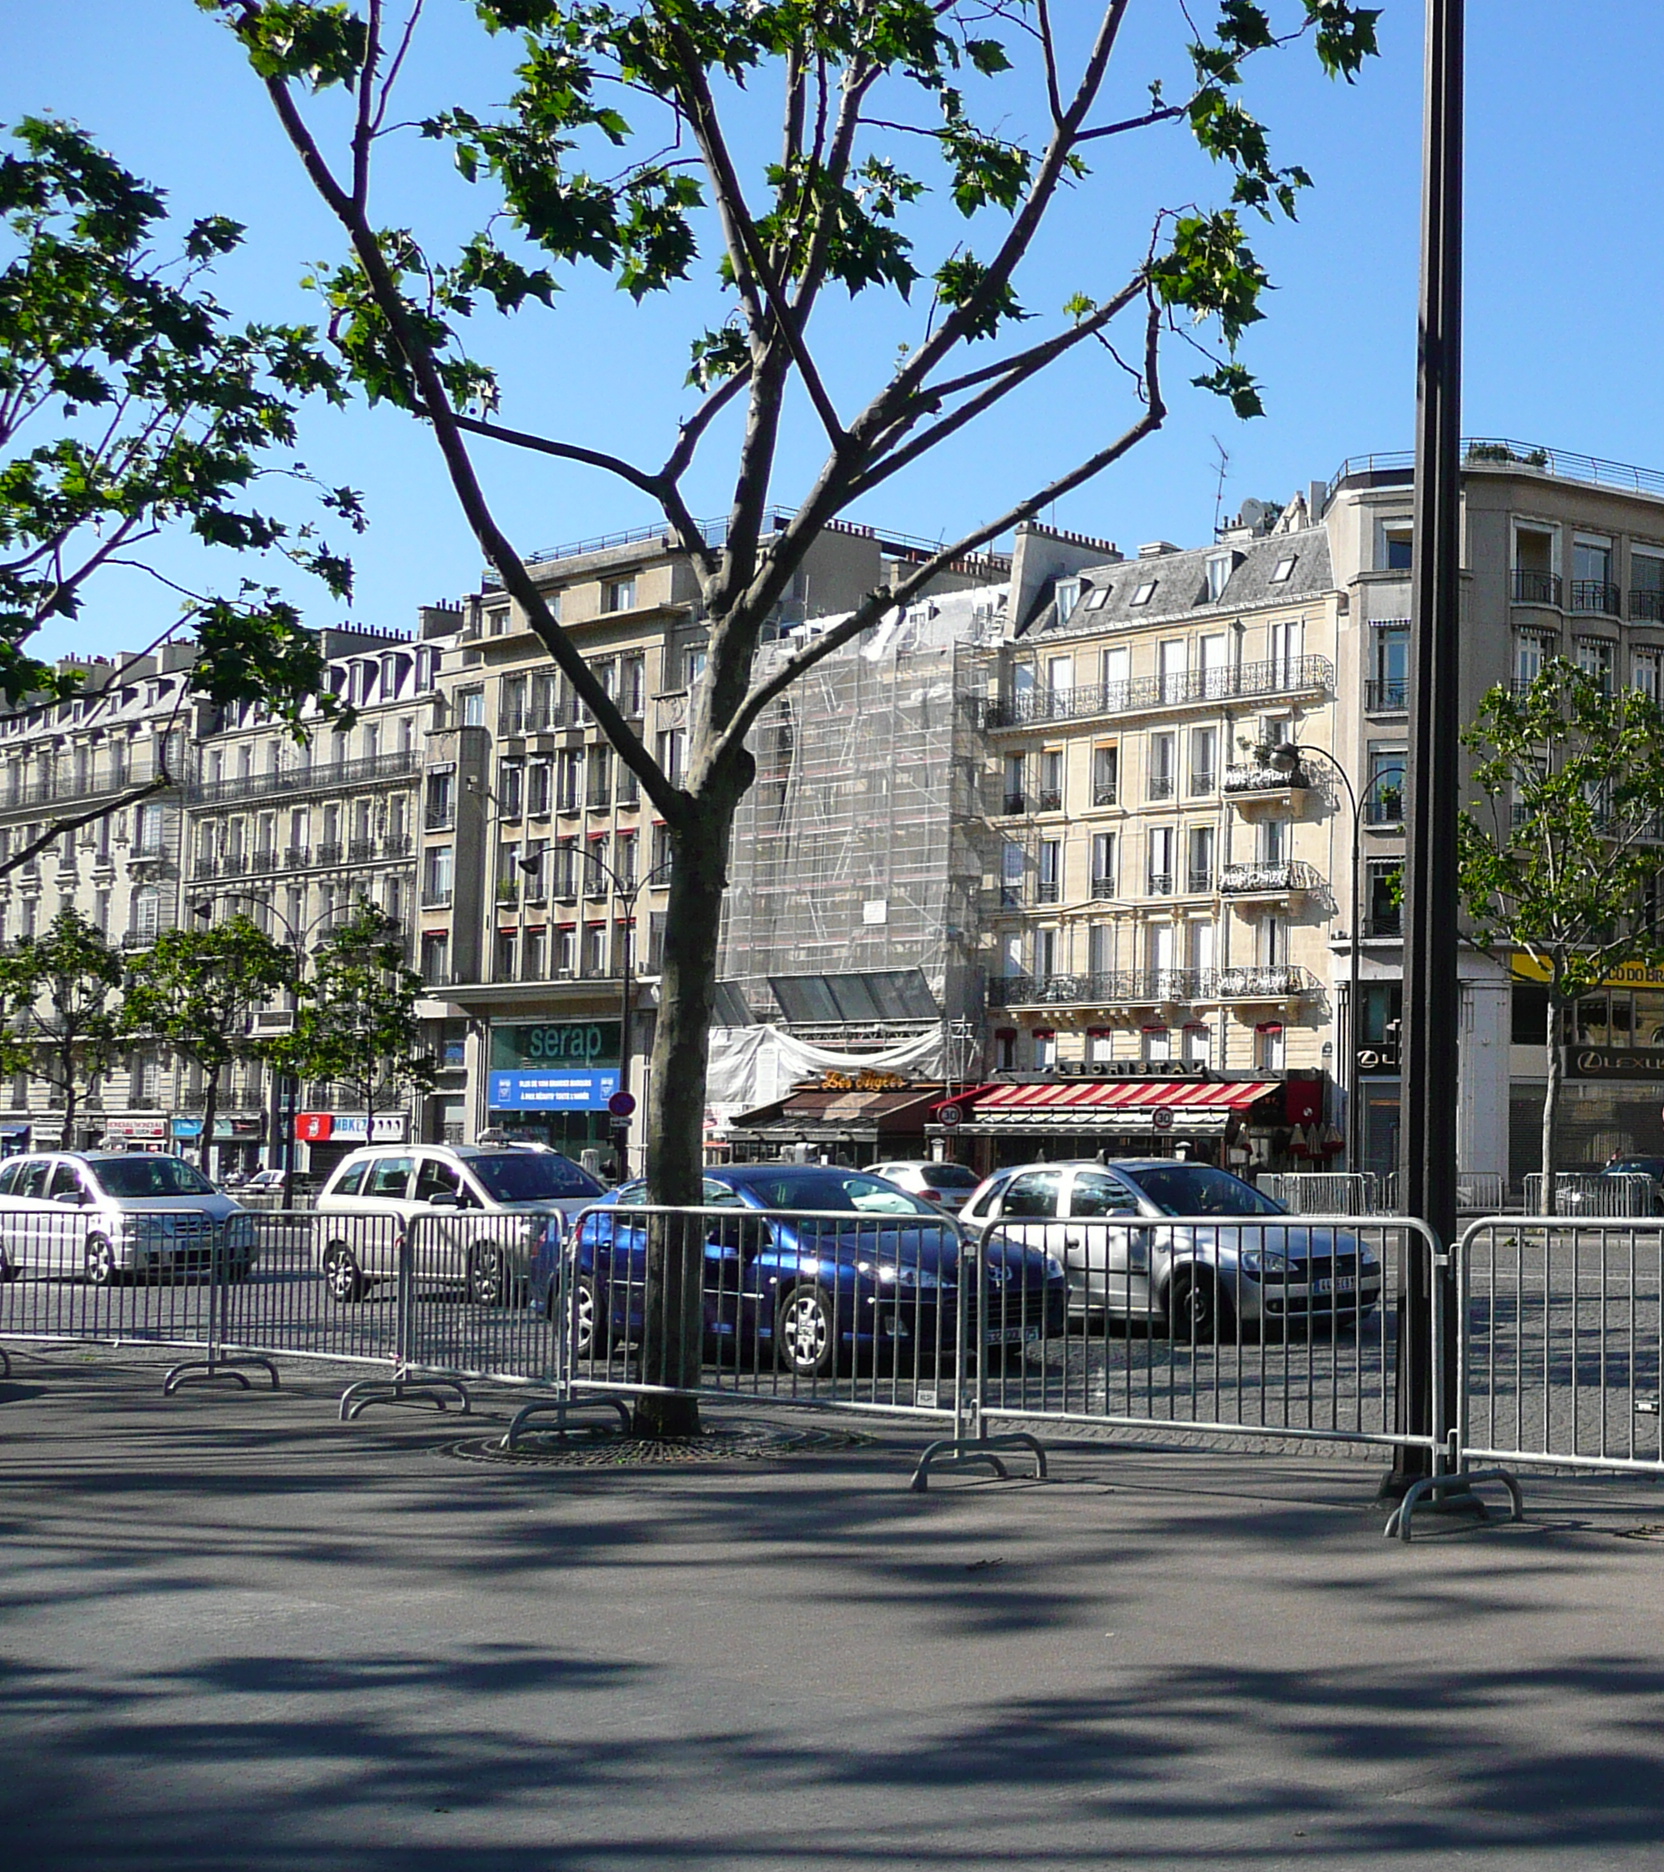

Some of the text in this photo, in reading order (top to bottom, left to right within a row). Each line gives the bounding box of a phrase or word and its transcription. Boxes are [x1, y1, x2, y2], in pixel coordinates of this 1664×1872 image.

[1627, 968, 1644, 981] DO
[530, 1027, 602, 1066] serap
[943, 1109, 957, 1120] 30
[1157, 1113, 1171, 1123] 30
